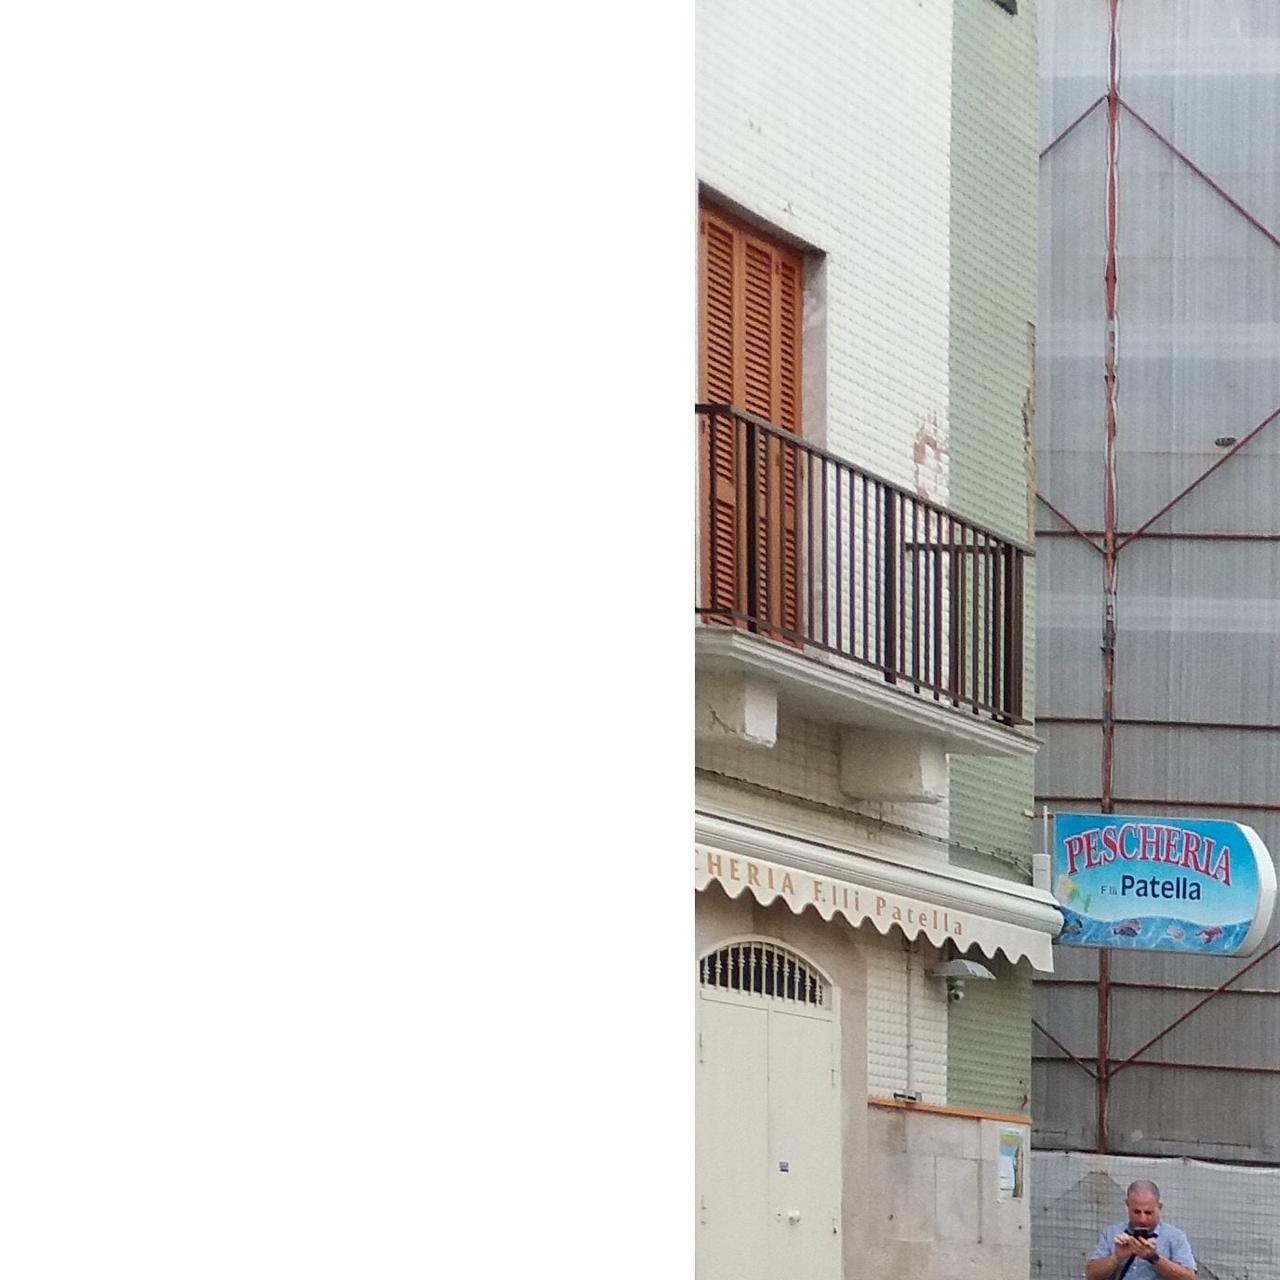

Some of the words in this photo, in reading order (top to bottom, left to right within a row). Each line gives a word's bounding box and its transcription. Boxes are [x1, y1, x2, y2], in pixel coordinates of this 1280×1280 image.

[1063, 823, 1232, 887] PESCHERIA
[695, 850, 795, 896] HERIA
[813, 879, 860, 911] F.lli
[874, 896, 963, 936] Patella
[1121, 875, 1201, 900] Patella
